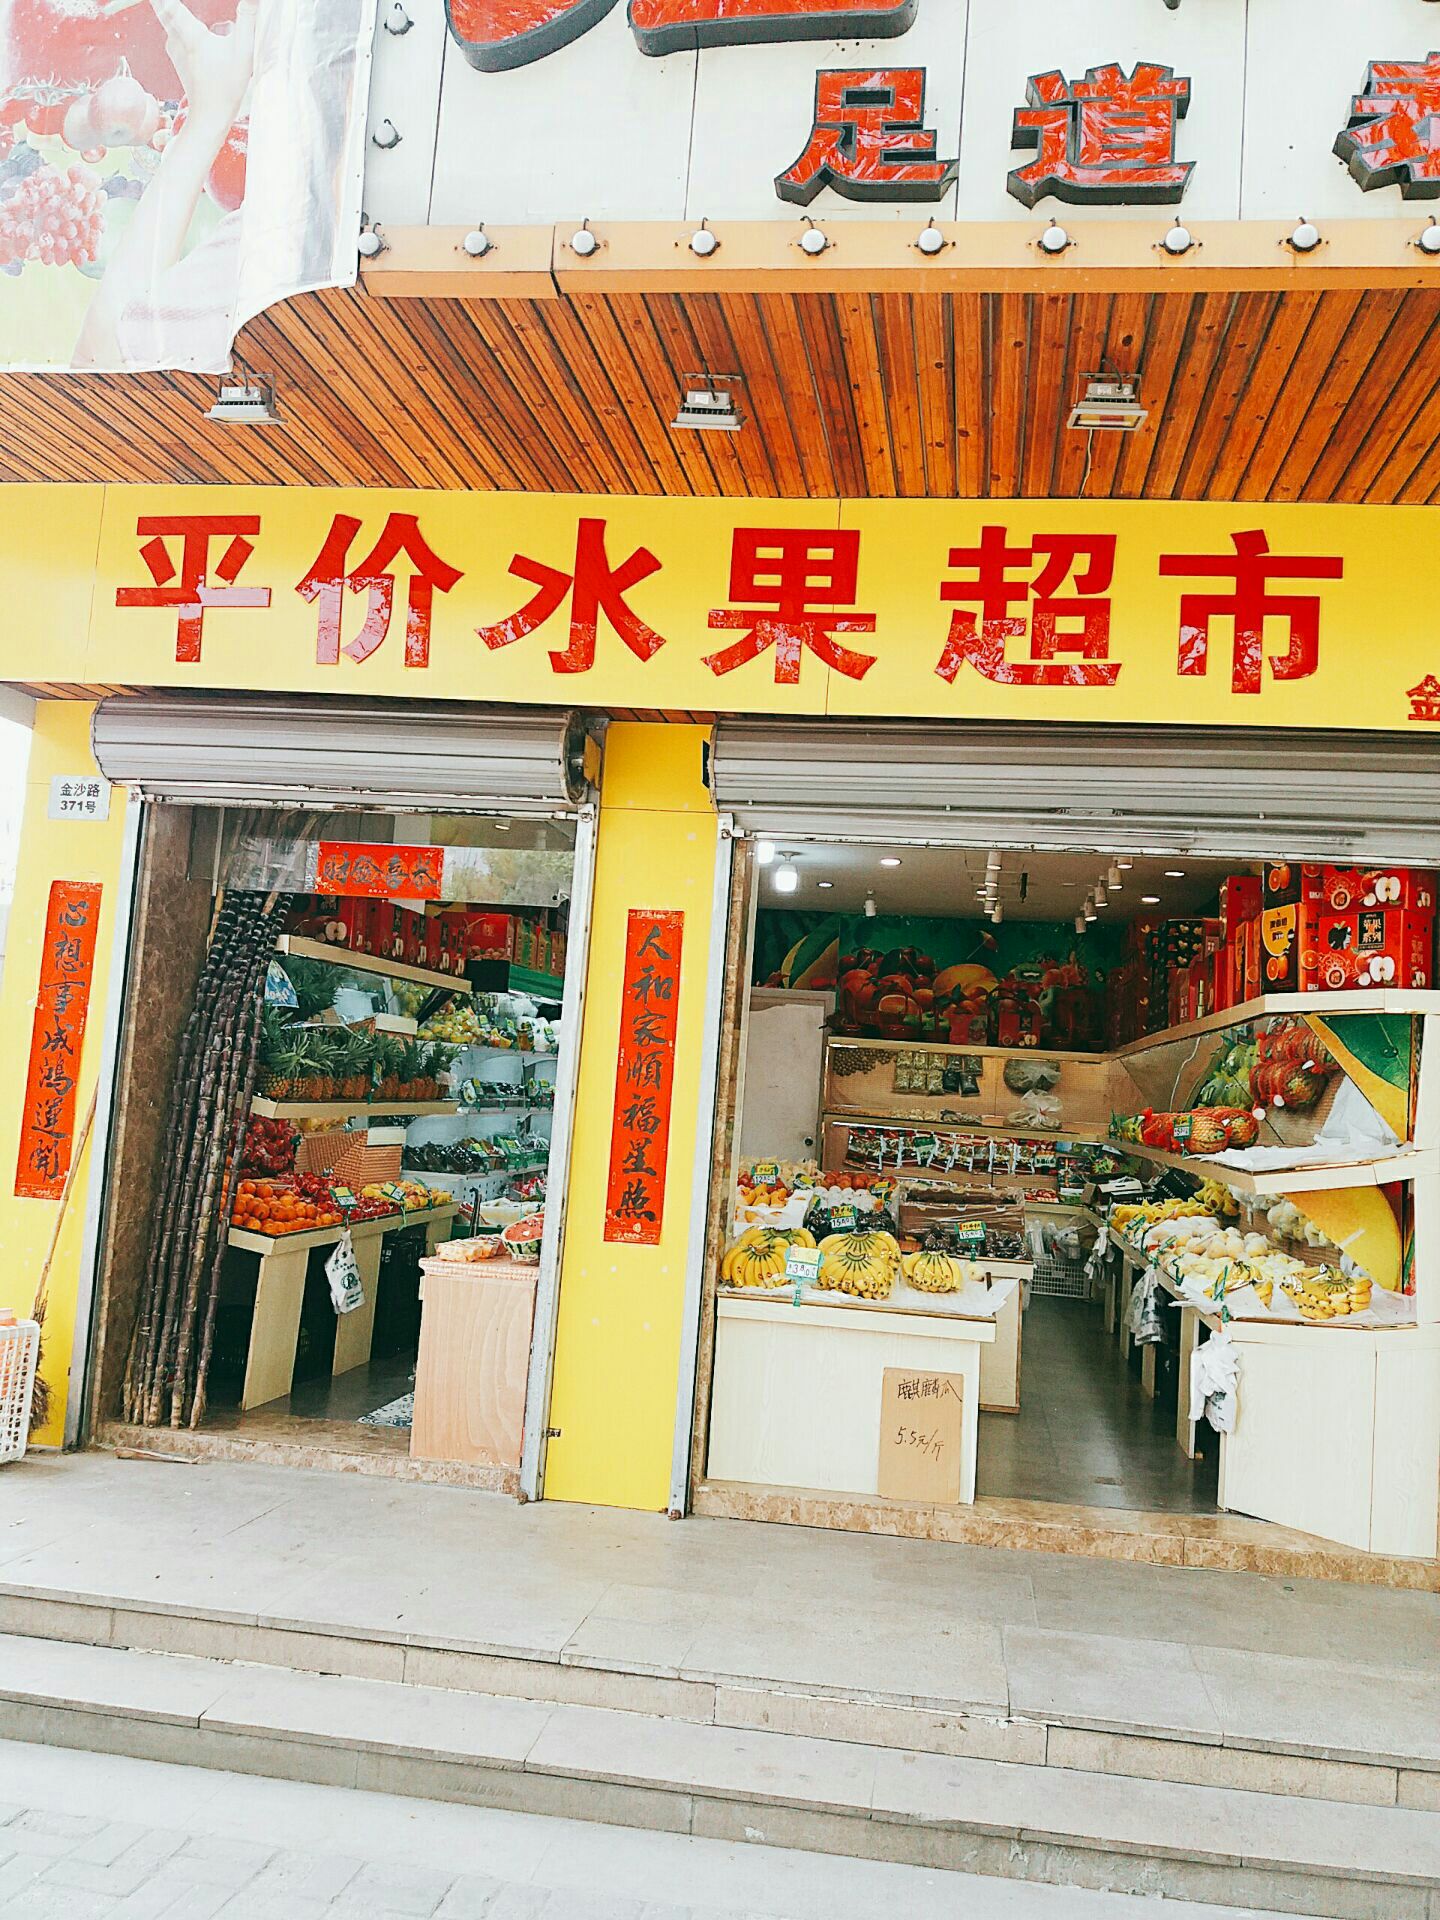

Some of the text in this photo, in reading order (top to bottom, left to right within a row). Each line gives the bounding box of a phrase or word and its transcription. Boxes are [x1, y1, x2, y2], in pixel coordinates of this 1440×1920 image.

[116, 513, 1344, 694] 平价水果超市
[60, 783, 100, 797] 金沙路
[60, 800, 96, 814] 371号
